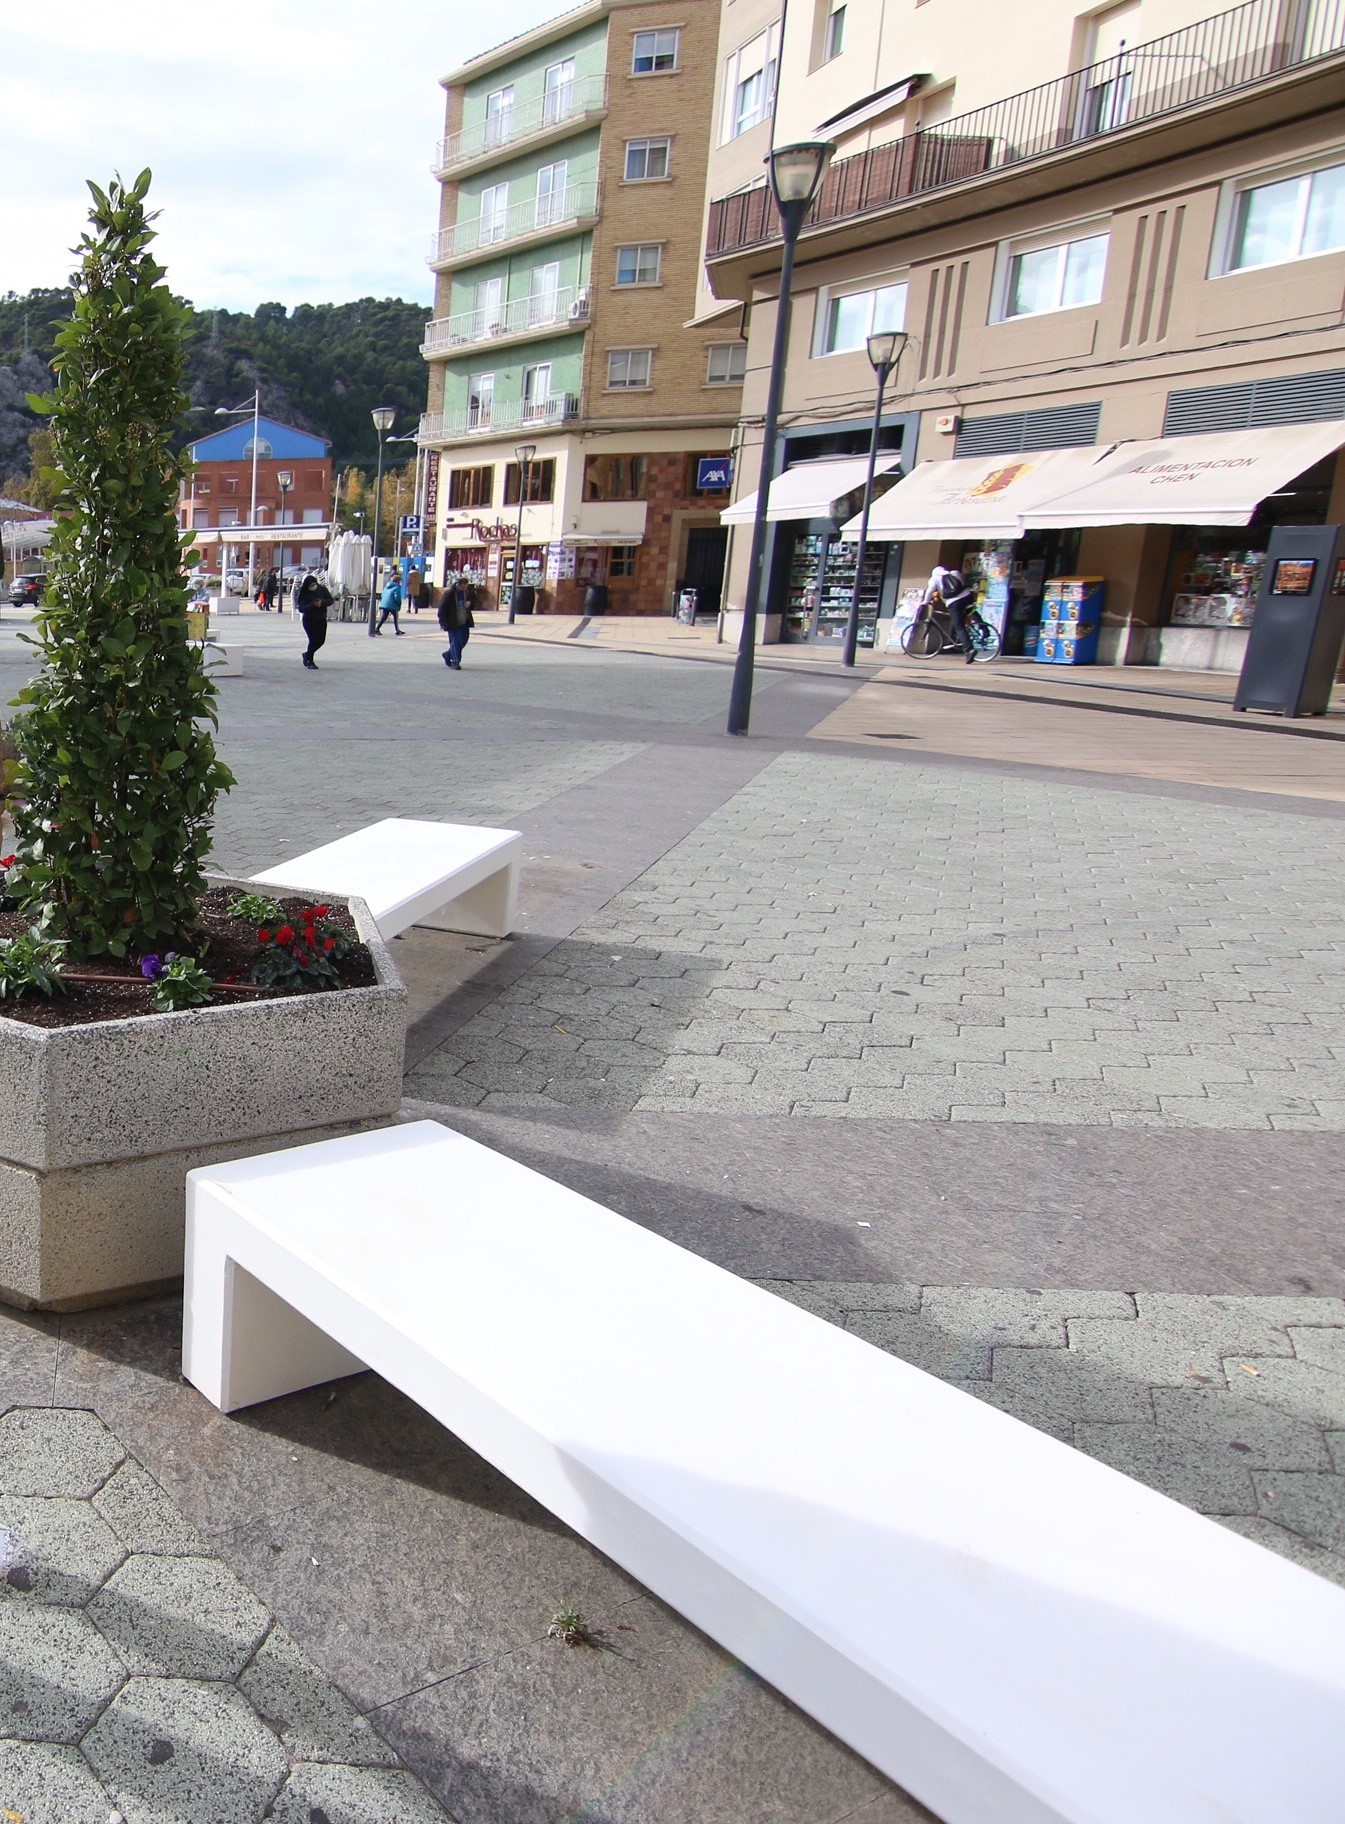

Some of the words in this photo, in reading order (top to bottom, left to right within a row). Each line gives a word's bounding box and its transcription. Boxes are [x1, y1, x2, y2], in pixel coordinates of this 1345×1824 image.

[1128, 457, 1260, 474] ALIMENTACION
[701, 470, 726, 482] AXA
[1149, 472, 1202, 485] CHEN
[427, 454, 438, 513] RESTAURANTE
[270, 531, 303, 540] RESTAURANTE
